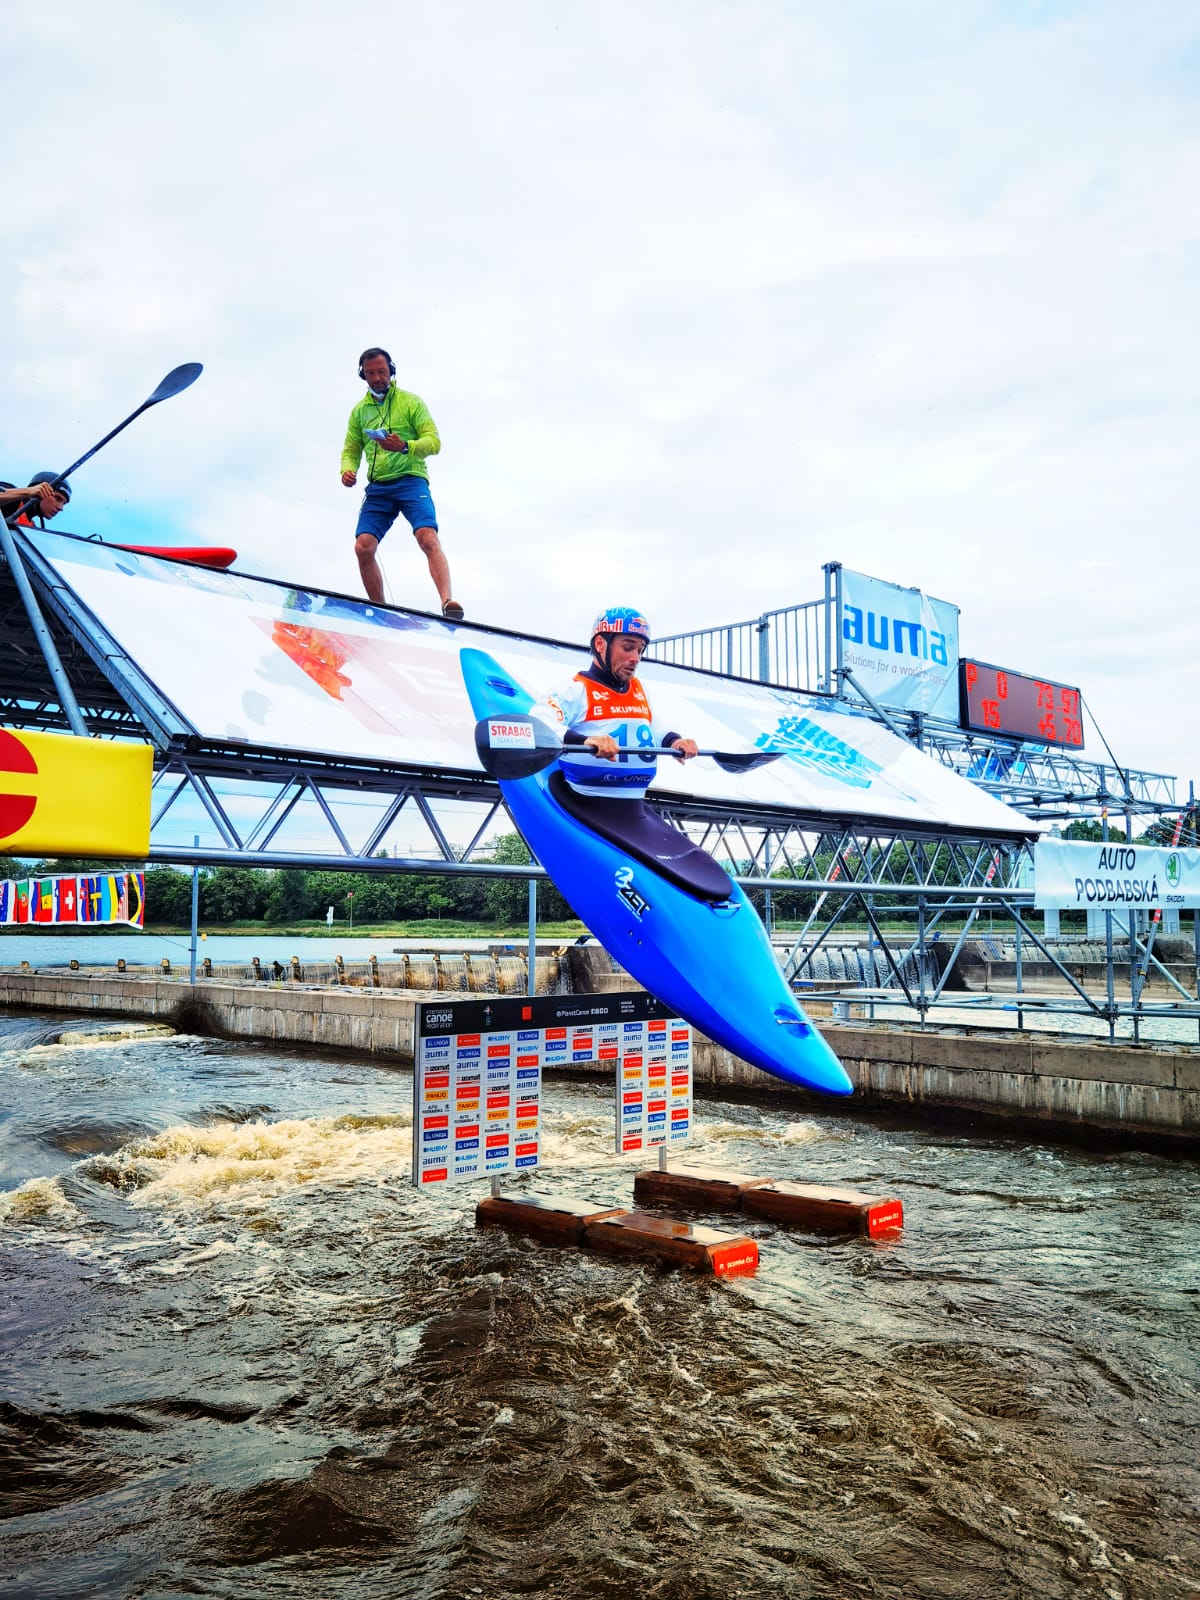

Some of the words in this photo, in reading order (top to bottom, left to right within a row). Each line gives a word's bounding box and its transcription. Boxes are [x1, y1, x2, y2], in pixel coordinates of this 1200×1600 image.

[843, 604, 948, 667] auma
[844, 651, 876, 671] Slutions
[981, 698, 1001, 729] 15
[491, 725, 532, 738] STRABAG
[608, 723, 657, 763] 18
[1098, 847, 1136, 871] AUTO
[1075, 874, 1159, 902] PODBABSKÁ
[426, 1013, 453, 1023] canoe
